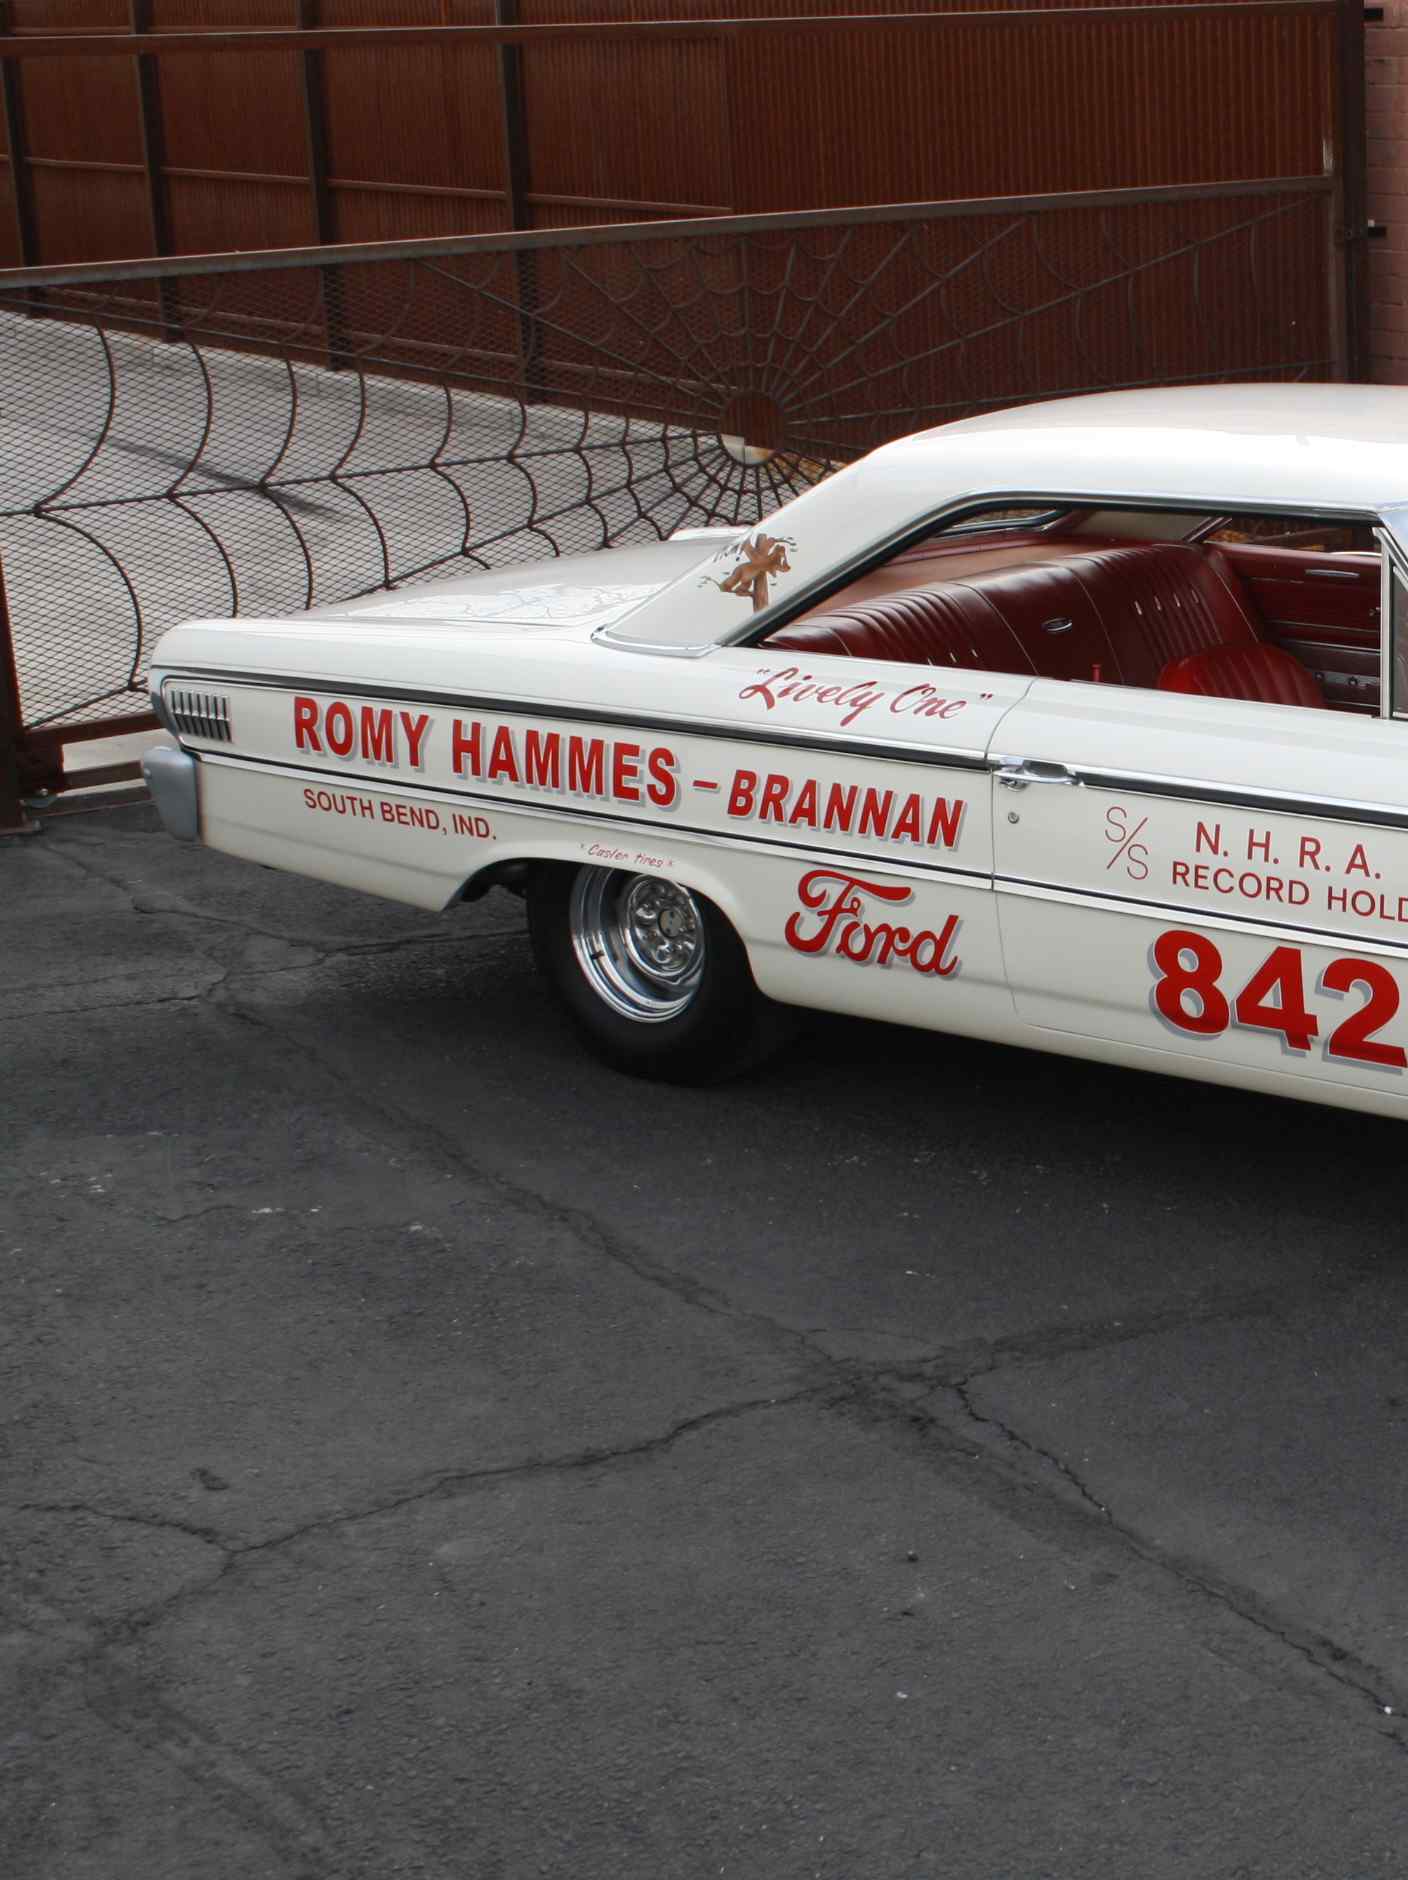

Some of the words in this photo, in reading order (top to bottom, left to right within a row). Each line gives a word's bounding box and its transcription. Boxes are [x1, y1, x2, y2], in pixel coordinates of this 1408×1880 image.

[293, 695, 433, 770] ROMY
[452, 719, 680, 809] HAMMES
[727, 768, 966, 849] BRANNAN
[303, 788, 375, 819] SOUTH
[380, 801, 448, 836] BEND,
[452, 814, 497, 841] IND.
[784, 868, 962, 977] Ford
[1171, 860, 1311, 906] RECORD
[1151, 929, 1408, 1073] 842
